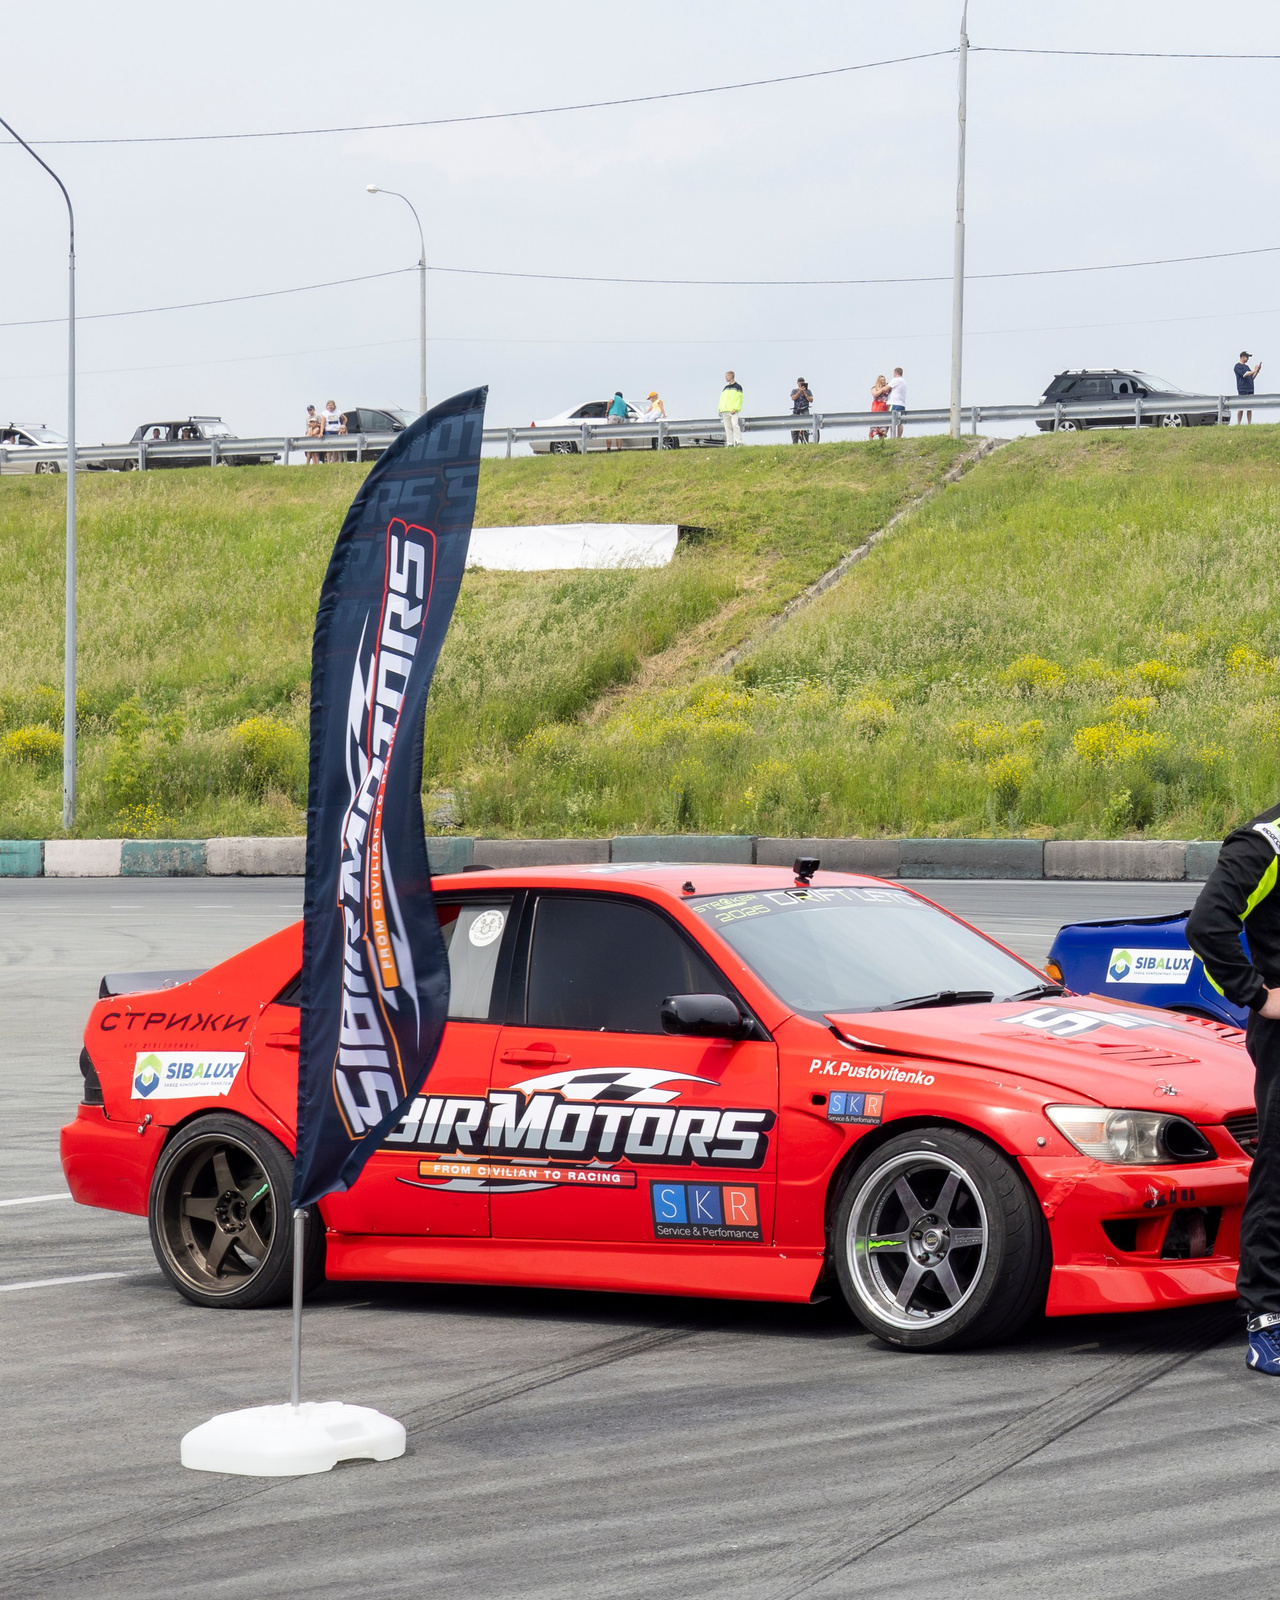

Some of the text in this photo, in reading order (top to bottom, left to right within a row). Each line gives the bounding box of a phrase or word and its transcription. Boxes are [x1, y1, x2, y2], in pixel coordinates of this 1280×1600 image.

[375, 794, 383, 817] TO
[370, 827, 383, 910] CIVILIAN
[763, 889, 851, 907] DRIFT
[715, 904, 772, 923] 2025
[374, 920, 394, 970] FROM
[1135, 956, 1192, 971] SIBALUX
[100, 1012, 251, 1032] СТРИЖИ
[165, 1062, 240, 1080] SIBALUX
[808, 1058, 936, 1086] P.K.Pustovitenko
[831, 1094, 879, 1114] SKR
[433, 1164, 622, 1184] FROM CIVILIAN TO RACING
[660, 1187, 750, 1222] SKR
[657, 1225, 760, 1239] Service & Perfomance
